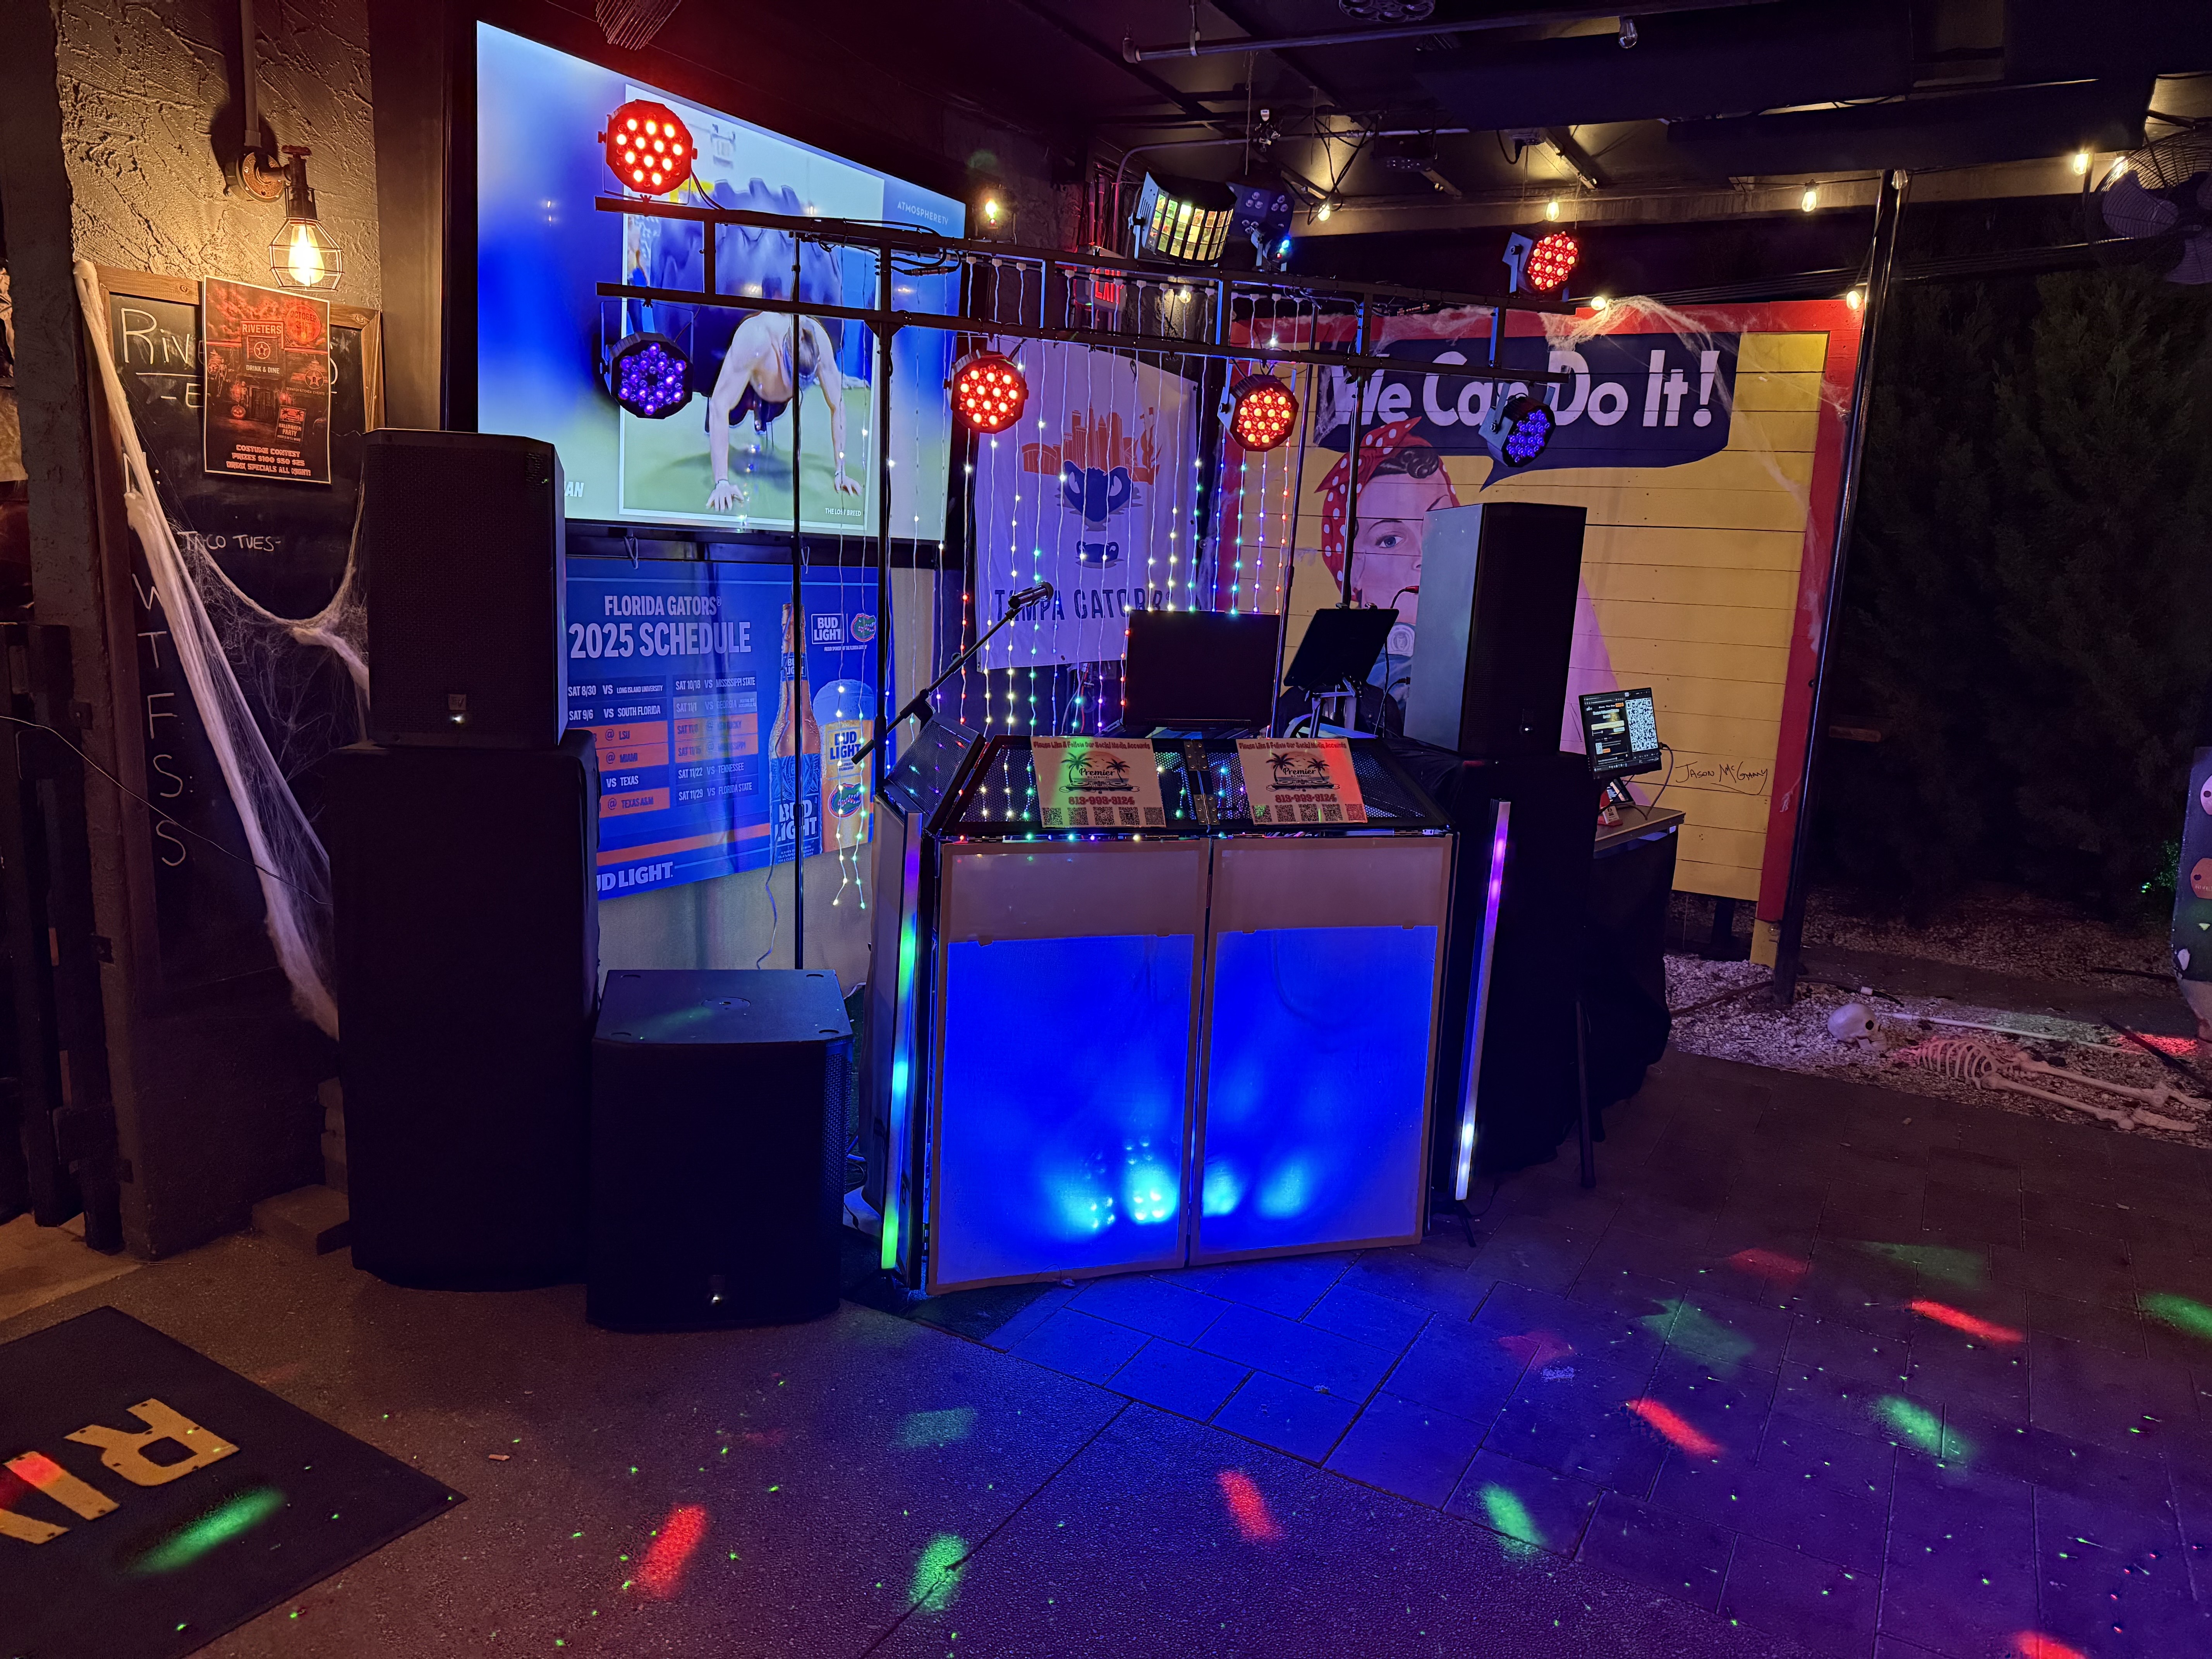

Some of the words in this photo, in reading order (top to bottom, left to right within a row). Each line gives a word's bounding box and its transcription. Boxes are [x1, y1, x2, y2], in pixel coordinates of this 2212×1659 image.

[290, 311, 317, 322] OCTOBER
[242, 324, 282, 334] RIVETERS
[1331, 354, 1412, 425] We
[1547, 350, 1628, 426] Do
[1642, 350, 1720, 427] It!
[279, 422, 302, 431] HALLOWEEN
[282, 429, 297, 437] PARTY
[232, 452, 256, 461] PRIZES
[236, 444, 269, 455] COSTUME
[270, 448, 300, 458] CONTEST
[226, 461, 247, 471] DRINK
[247, 463, 277, 473] SPECIALS
[278, 466, 290, 474] ALL
[291, 467, 311, 476] NIGHT!
[177, 531, 226, 551] TACO
[605, 595, 665, 616] FLORIDA
[994, 589, 1065, 620] TMPA
[817, 617, 838, 629] BUD
[568, 623, 634, 658] 2025
[639, 622, 751, 657] SCHEDULE
[814, 628, 842, 641] LIGHT
[675, 680, 686, 690] SAT
[687, 680, 701, 691] 10/18
[704, 680, 713, 689] VS
[716, 678, 742, 688] MISSISSIPPI
[742, 677, 756, 686] STATE
[568, 686, 580, 697] SAT
[582, 685, 596, 697] 8/30
[603, 685, 613, 695] VS
[569, 710, 582, 721] SAT
[582, 709, 593, 721] 9/6
[603, 708, 614, 718] VS
[618, 707, 637, 717] SOUTH
[637, 705, 661, 716] FLORIDA
[676, 702, 687, 713] SAT
[687, 701, 697, 713] 11/1
[705, 701, 714, 710] VS
[717, 700, 737, 709] GEORGIA
[606, 728, 615, 741] @
[620, 731, 630, 740] LSU
[677, 725, 688, 734] SAT
[835, 731, 857, 746] BUD
[606, 752, 615, 764] @
[620, 753, 638, 763] MIAMI
[678, 747, 688, 756] SAT
[830, 744, 861, 760] LIGHT
[678, 769, 689, 779] SAT
[690, 767, 703, 778] 11/22
[706, 766, 715, 775] VS
[718, 762, 744, 774] TENNESSEE
[606, 778, 617, 788] VS
[620, 775, 639, 786] TEXAS
[678, 790, 689, 801] SAT
[690, 789, 703, 800] 11/29
[707, 787, 716, 797] VS
[718, 784, 738, 795] FLORIDA
[738, 782, 752, 792] STATE
[608, 798, 617, 810] @
[621, 798, 639, 809] TEXAS
